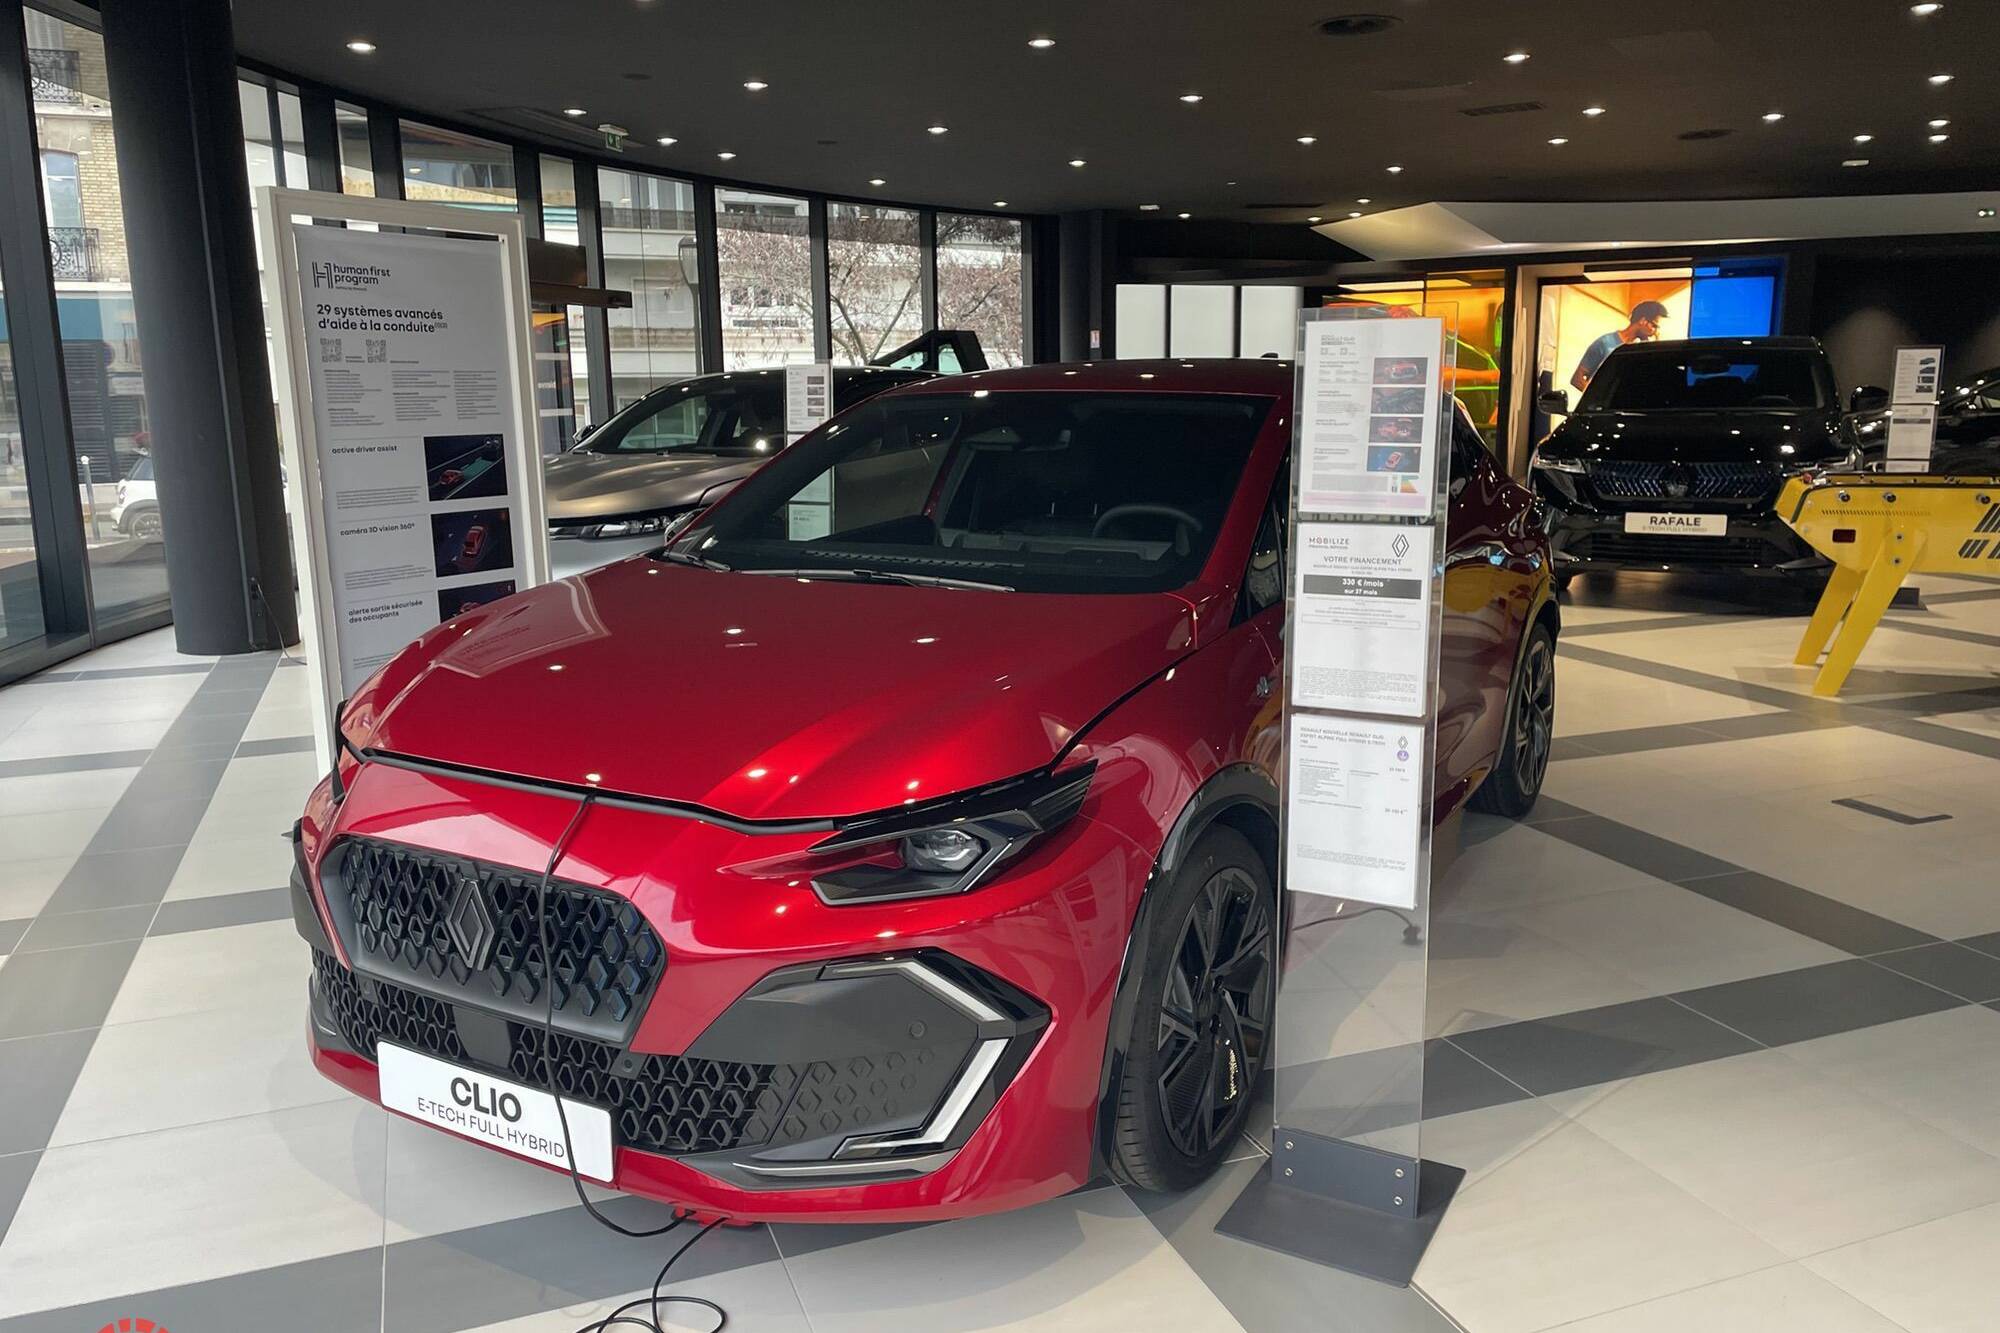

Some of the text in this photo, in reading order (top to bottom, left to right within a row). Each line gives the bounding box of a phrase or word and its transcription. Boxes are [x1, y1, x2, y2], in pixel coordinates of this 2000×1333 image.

[333, 263, 390, 277] human first
[334, 274, 379, 285] program
[317, 304, 443, 320] 29 systèmes avancés
[319, 318, 357, 330] d'aide
[360, 318, 367, 330] à
[370, 320, 380, 331] la
[383, 321, 435, 333] conduite
[1650, 516, 1701, 526] RAFALE
[340, 528, 368, 536] caméra
[379, 524, 399, 532] vision
[1350, 557, 1402, 565] FINANCEMENT
[348, 600, 423, 616] alerte sortie sécurisée
[349, 612, 399, 624] des occupants
[450, 1077, 522, 1122] CLIO
[417, 1097, 565, 1158] E-TECH FULL HYBRID
